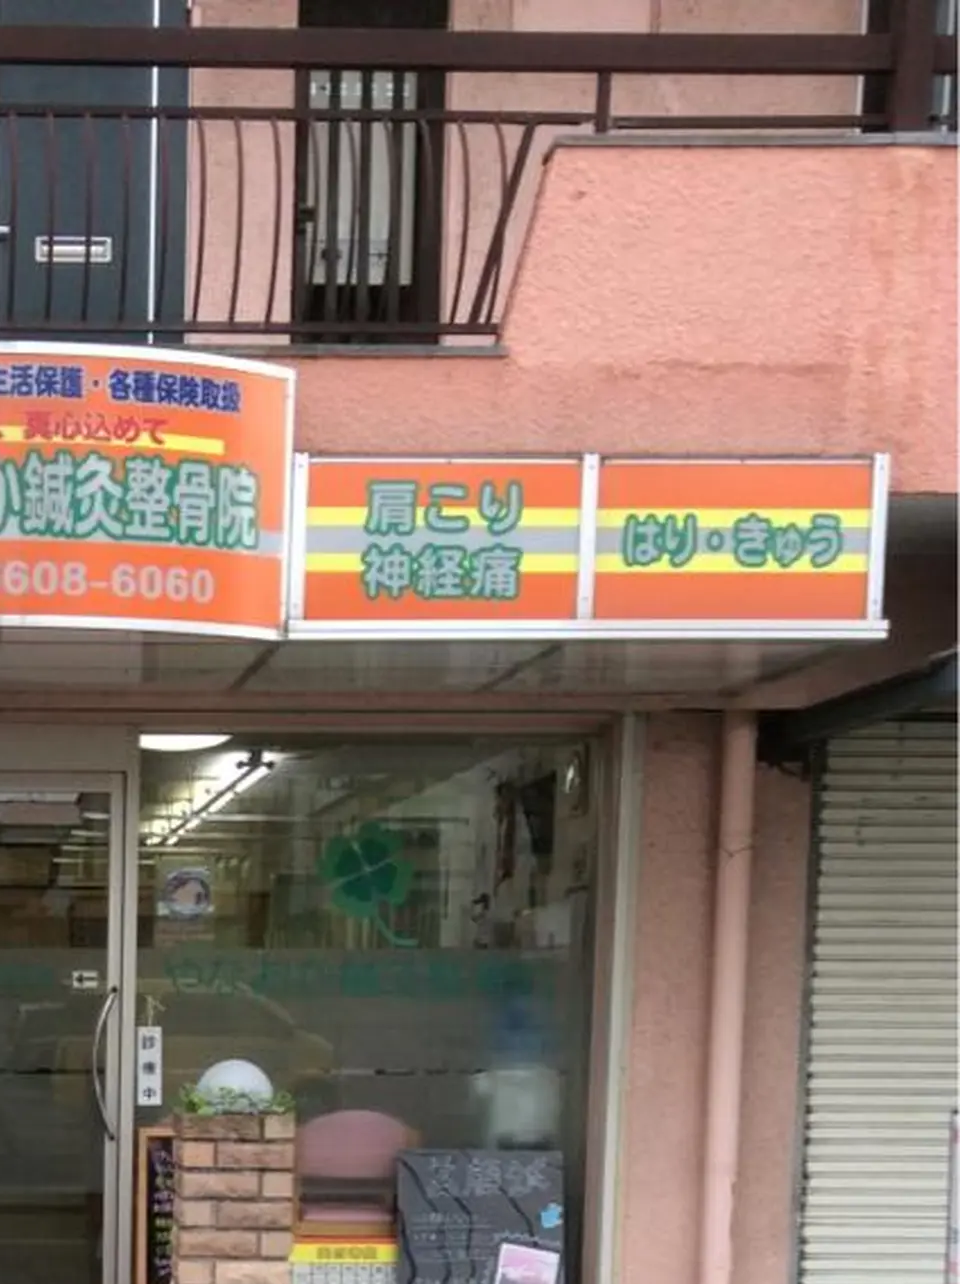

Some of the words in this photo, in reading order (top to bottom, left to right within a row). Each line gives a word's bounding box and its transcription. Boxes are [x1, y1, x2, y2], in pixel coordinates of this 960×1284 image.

[364, 479, 524, 534] 肩こり
[621, 513, 844, 568] はり・きゅう
[361, 545, 524, 600] 神経痛
